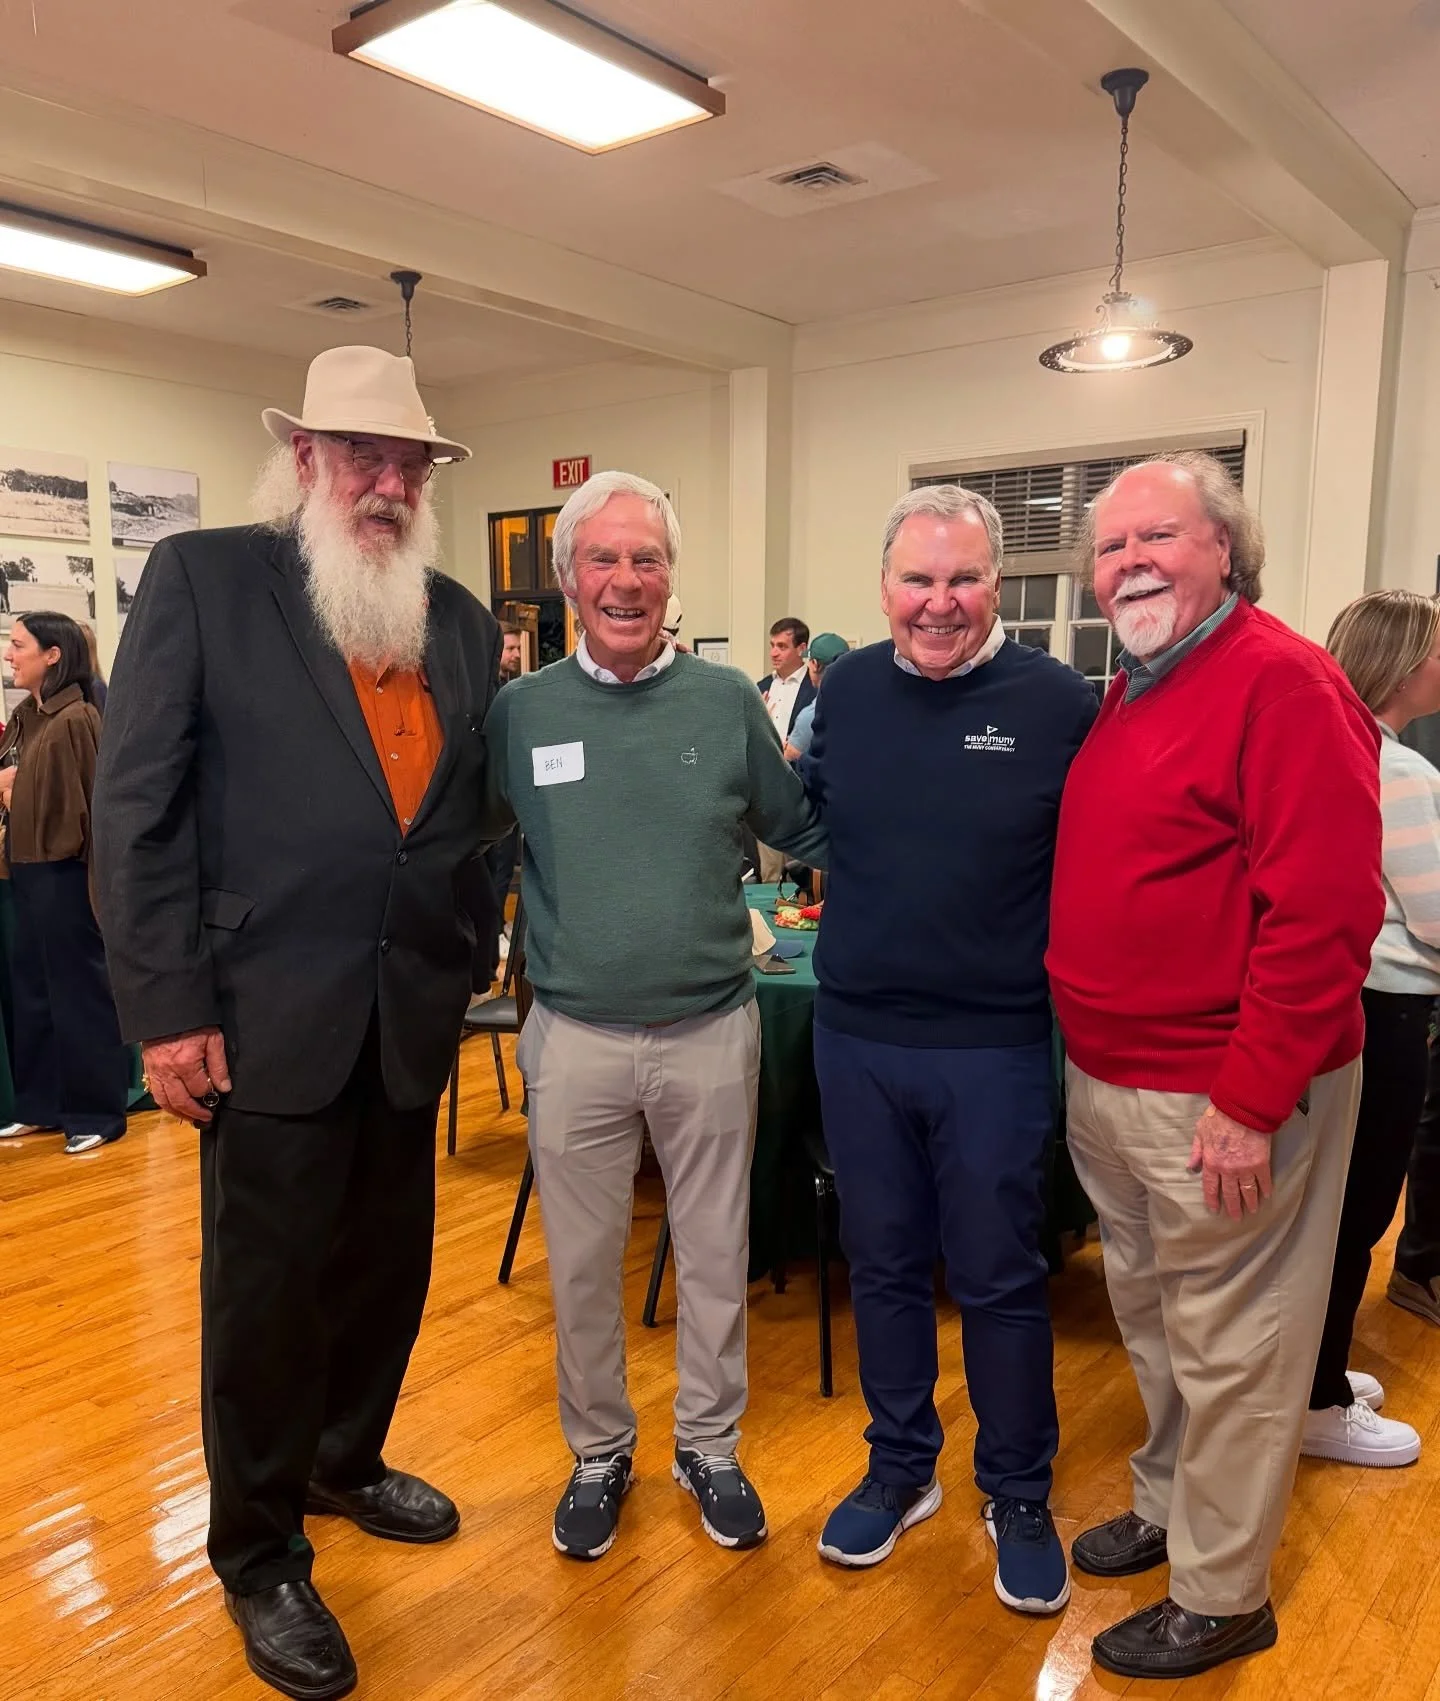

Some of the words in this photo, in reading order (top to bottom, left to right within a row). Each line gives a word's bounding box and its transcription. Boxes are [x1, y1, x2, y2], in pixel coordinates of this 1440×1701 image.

[560, 460, 585, 485] EXIT
[990, 736, 1015, 746] muny
[545, 757, 563, 771] BEN
